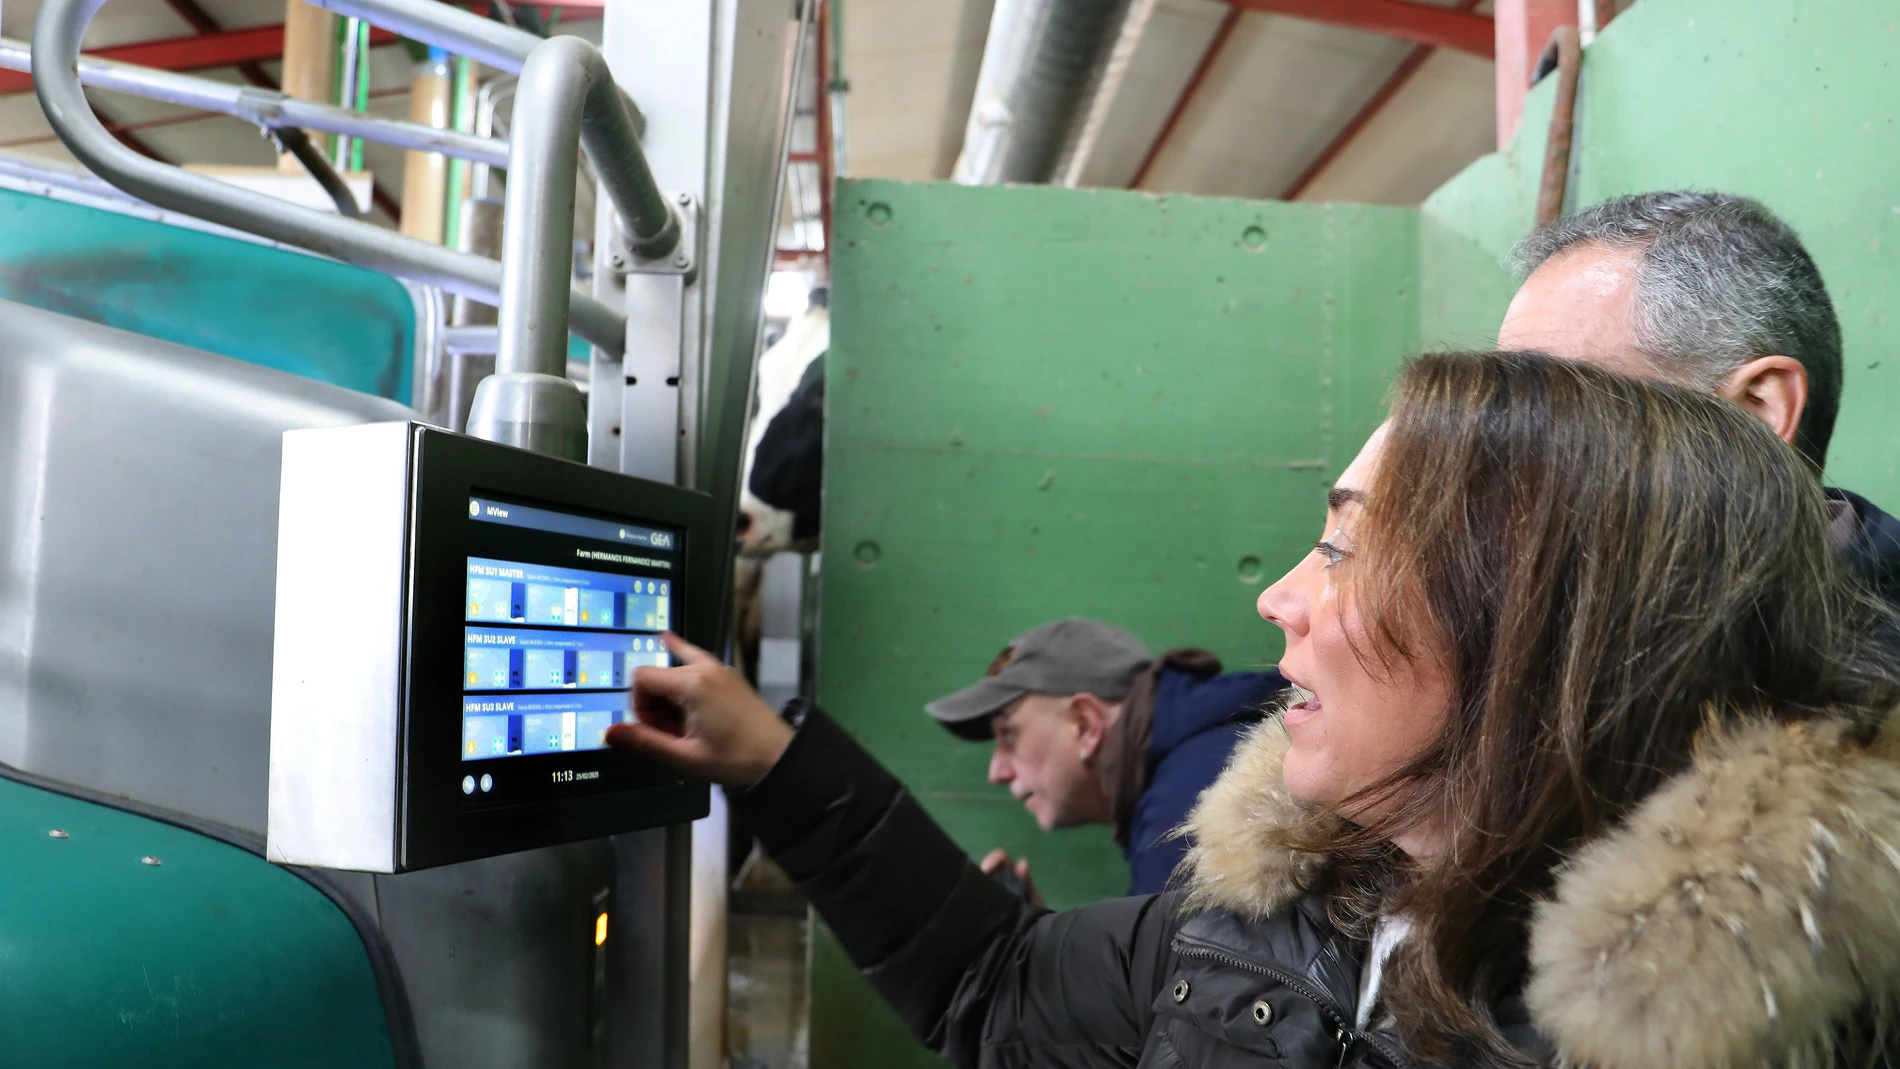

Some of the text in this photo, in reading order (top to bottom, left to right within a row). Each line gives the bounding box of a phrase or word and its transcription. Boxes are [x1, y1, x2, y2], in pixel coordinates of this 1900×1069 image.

[650, 532, 670, 547] GEA
[576, 548, 590, 559] Farm
[499, 568, 524, 579] MASTER
[467, 634, 483, 644] HFM
[483, 634, 497, 645] SU2
[497, 635, 516, 645] SLAVE
[465, 703, 481, 713] HFM
[495, 702, 514, 711] SLAVE
[551, 769, 573, 783] 11:13
